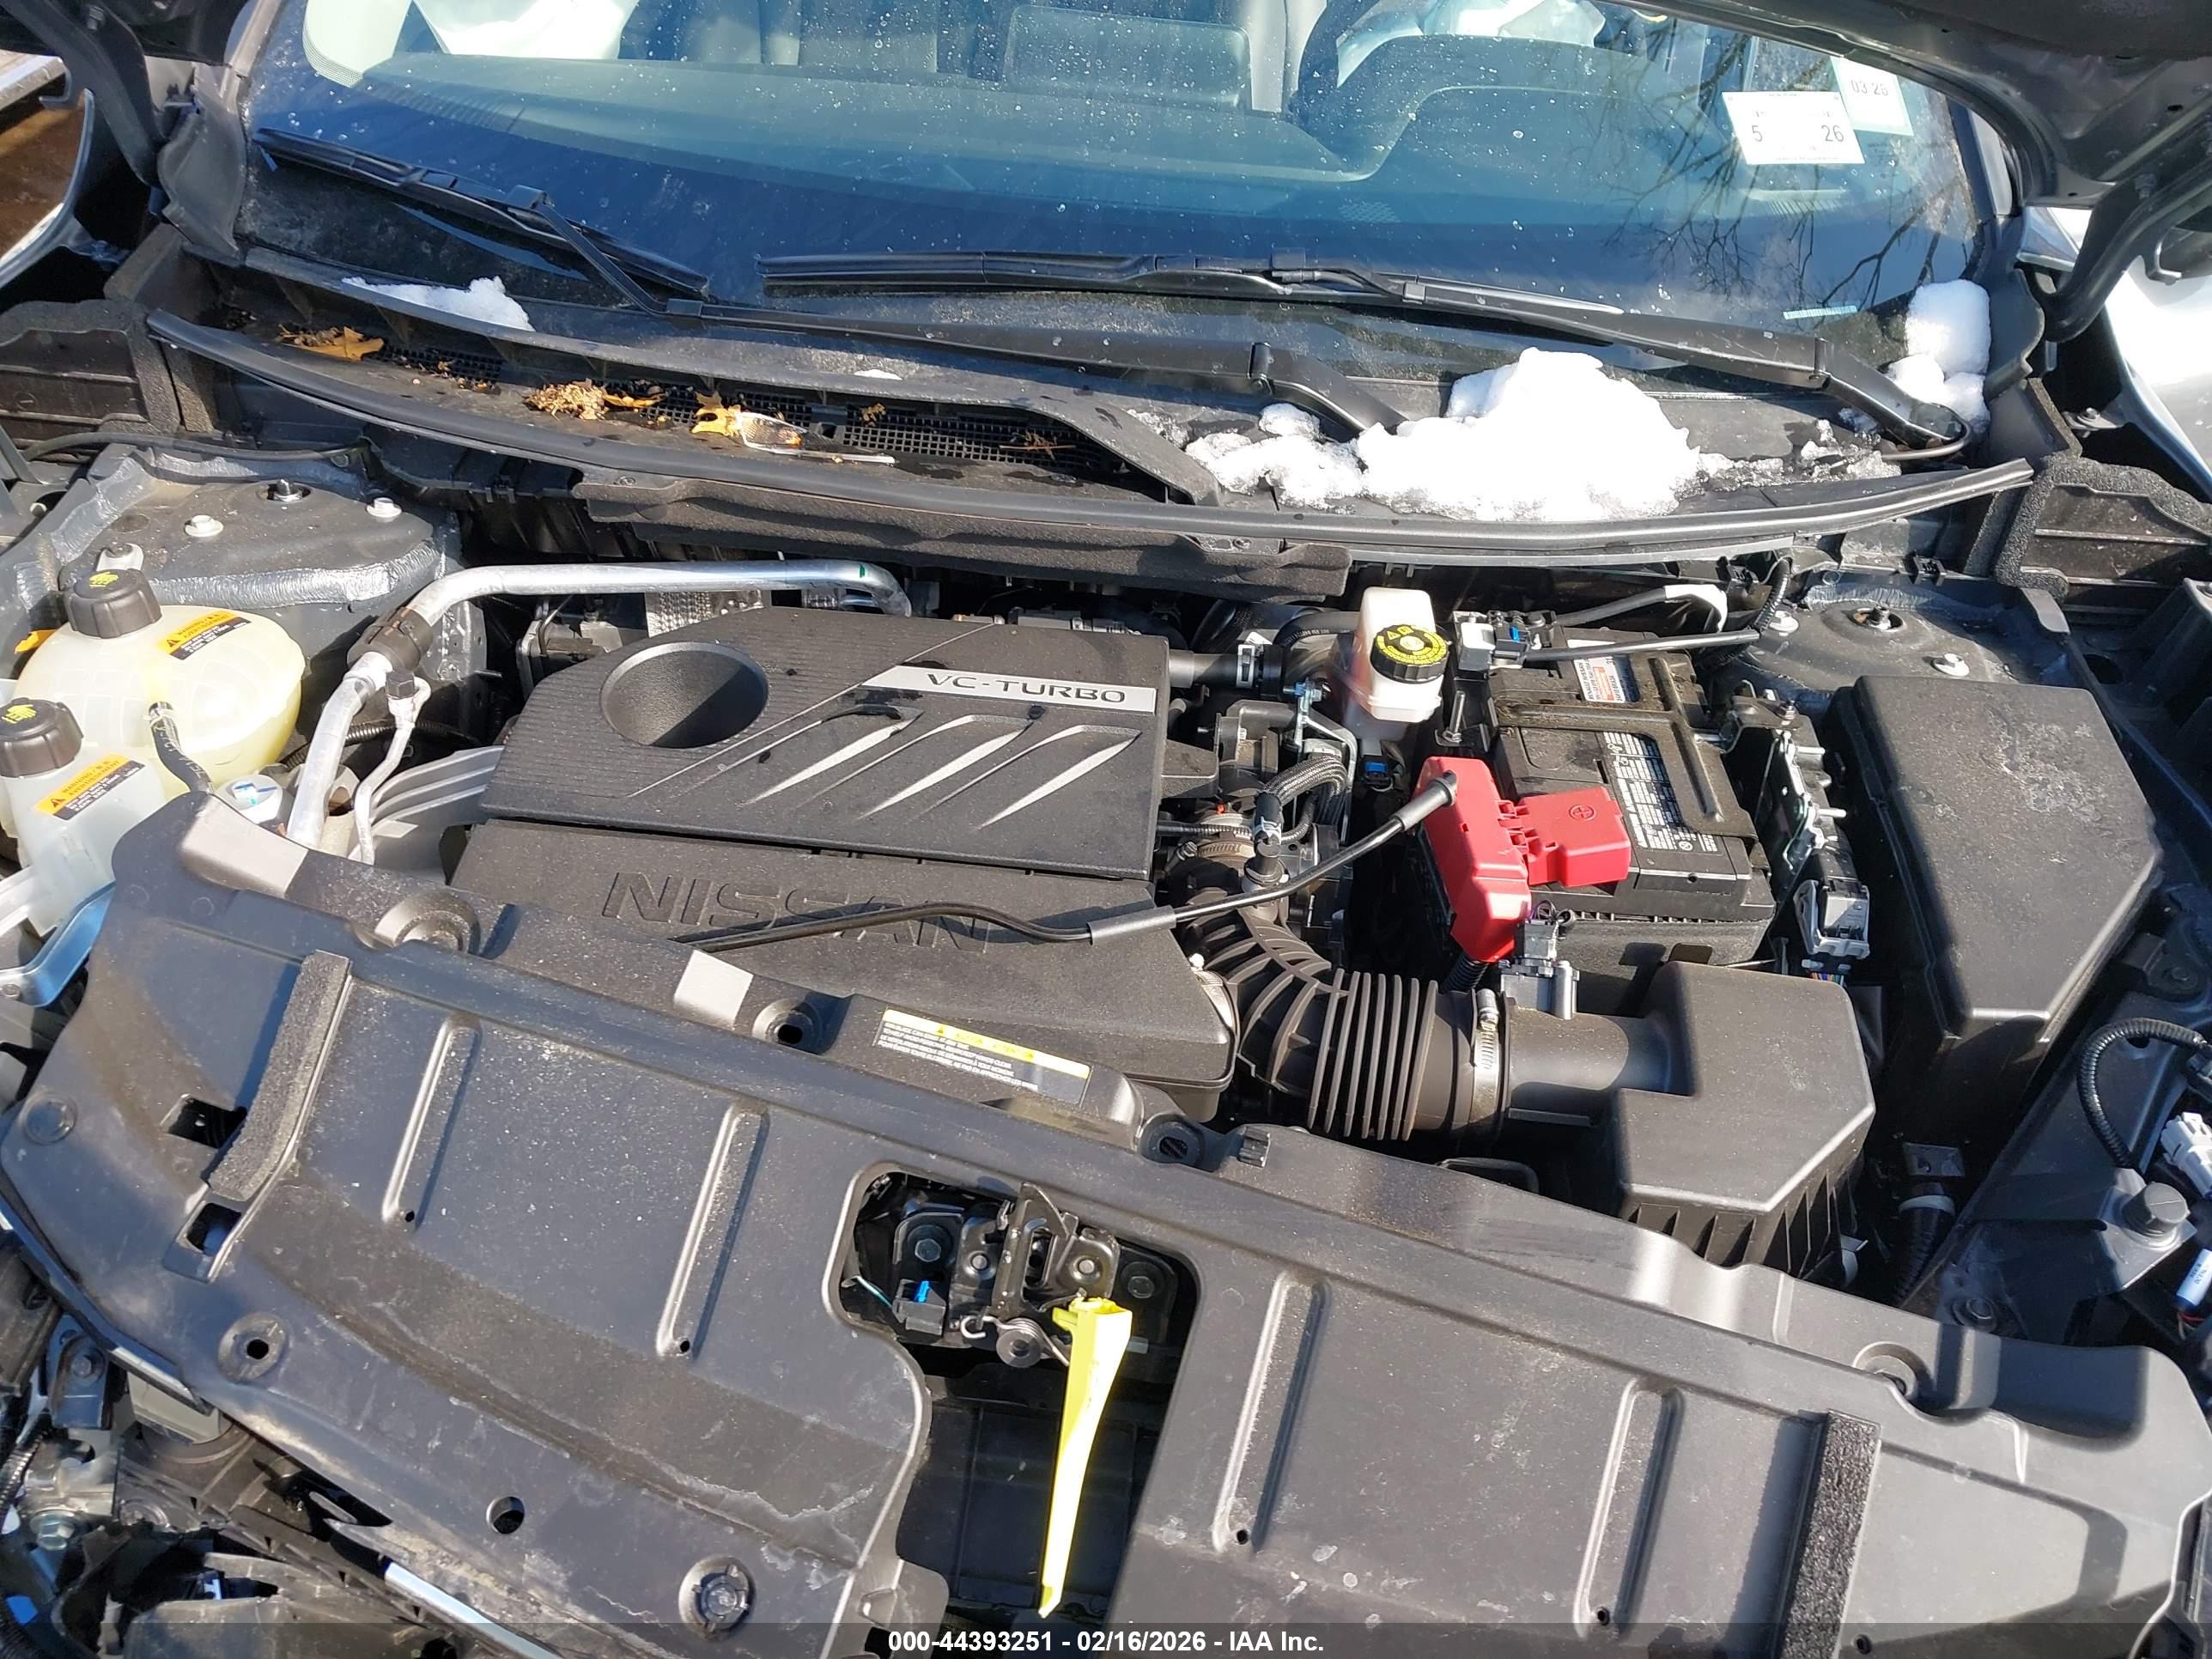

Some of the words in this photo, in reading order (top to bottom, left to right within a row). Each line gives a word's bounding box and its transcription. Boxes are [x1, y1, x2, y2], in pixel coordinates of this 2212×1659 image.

[1751, 125, 1763, 143] 5
[1821, 125, 1844, 143] 26
[927, 673, 1126, 703] VC-TURBO
[602, 871, 990, 953] NISSAN
